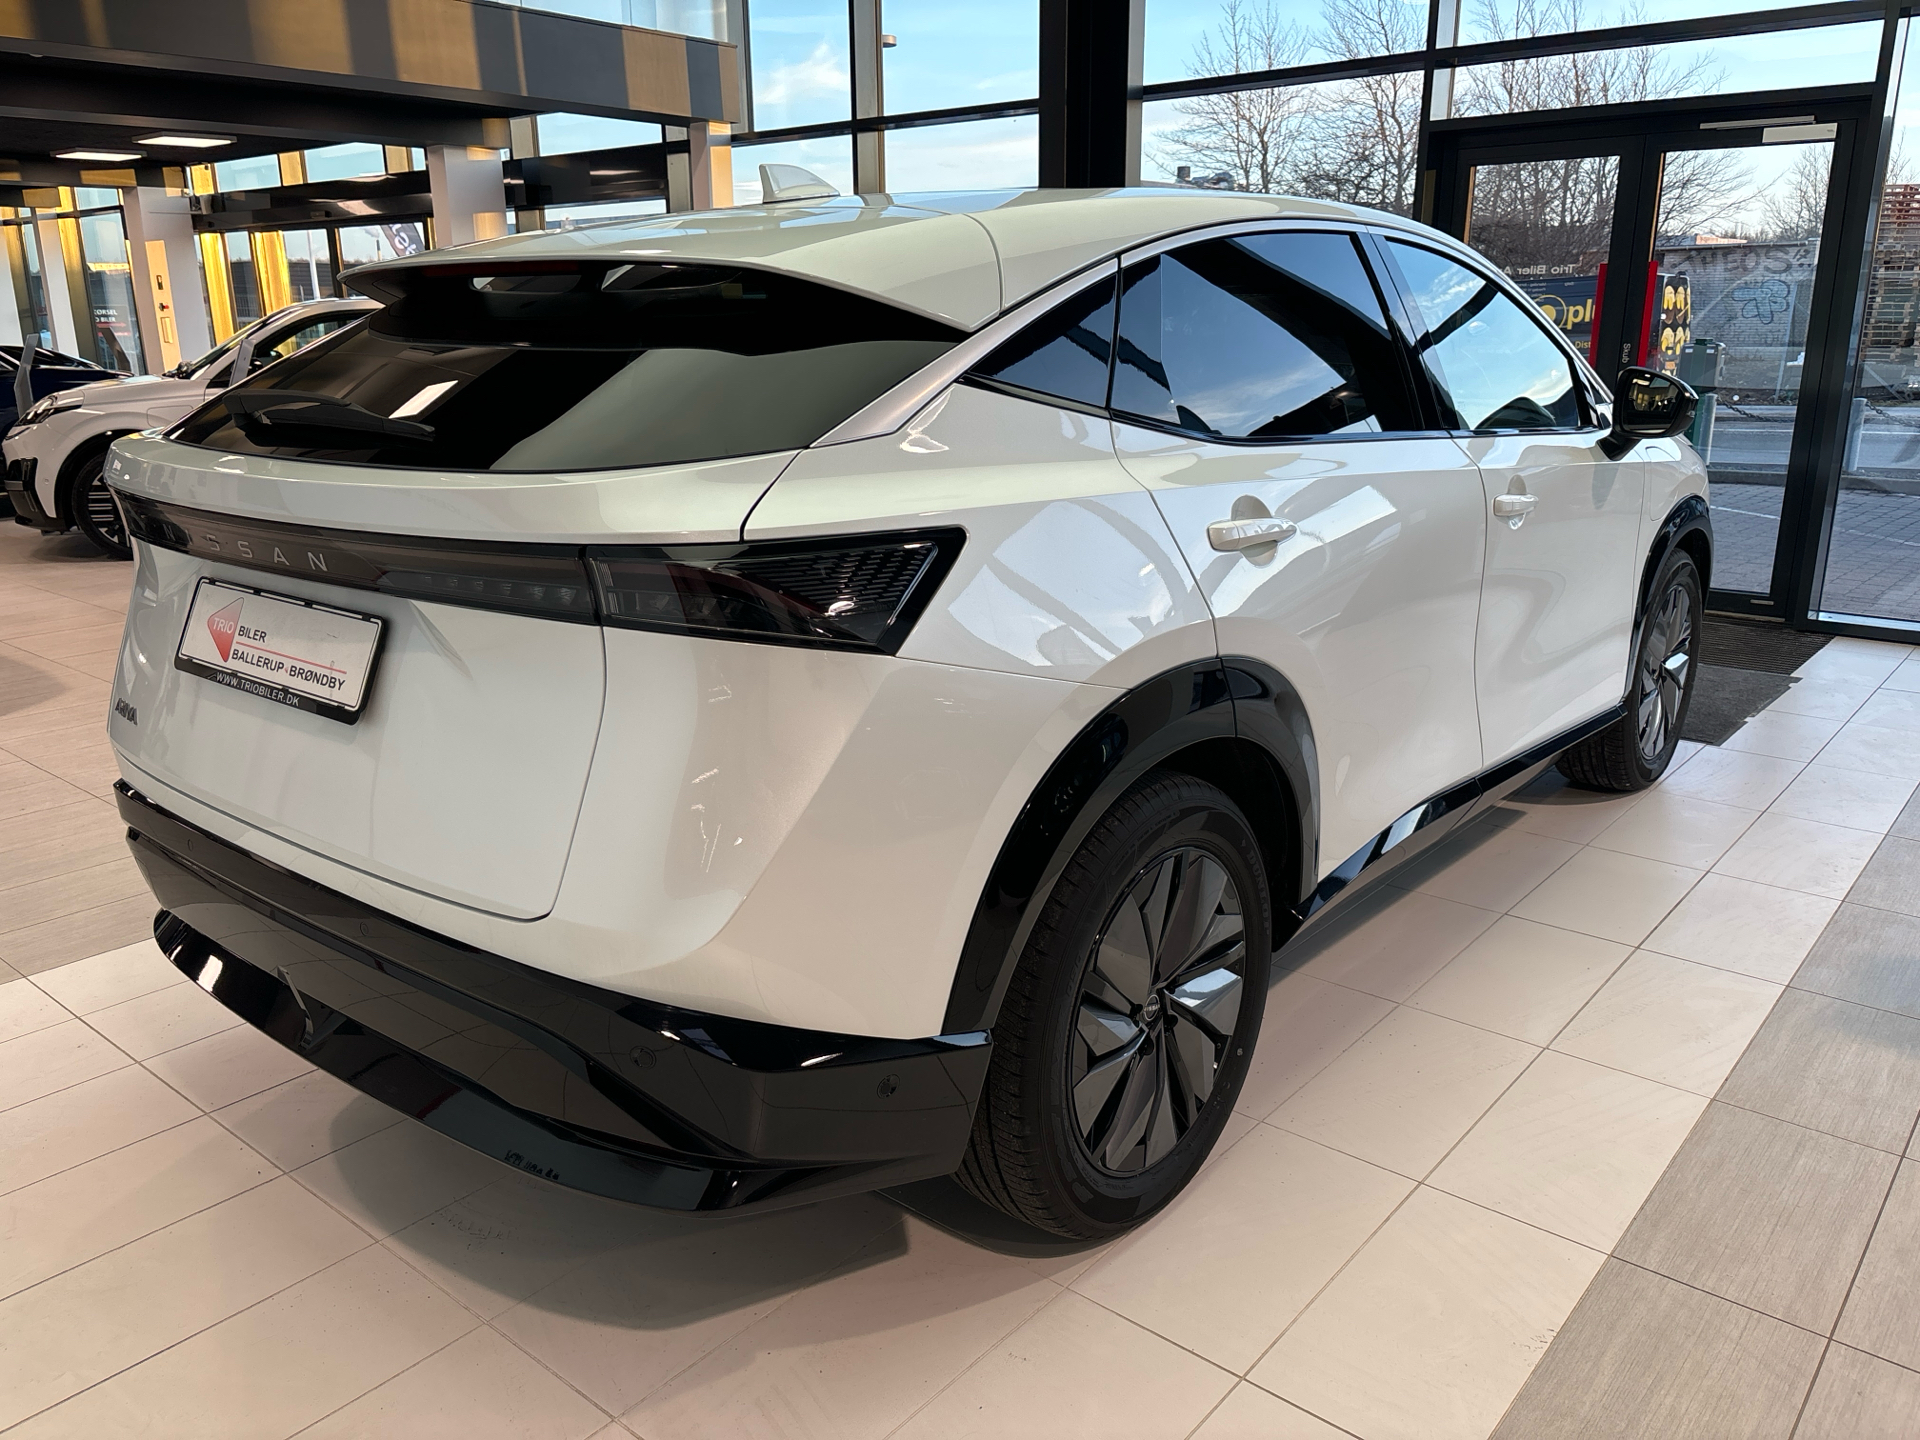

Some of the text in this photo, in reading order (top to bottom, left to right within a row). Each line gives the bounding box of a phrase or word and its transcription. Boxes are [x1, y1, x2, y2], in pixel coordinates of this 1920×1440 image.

[1621, 343, 1631, 364] Skub
[163, 523, 328, 572] NISSAN
[213, 617, 268, 643] TRIO BILER
[231, 648, 346, 691] BALLERUP BRØNDBY
[216, 671, 300, 707] WWW.TRIOBILER.DK
